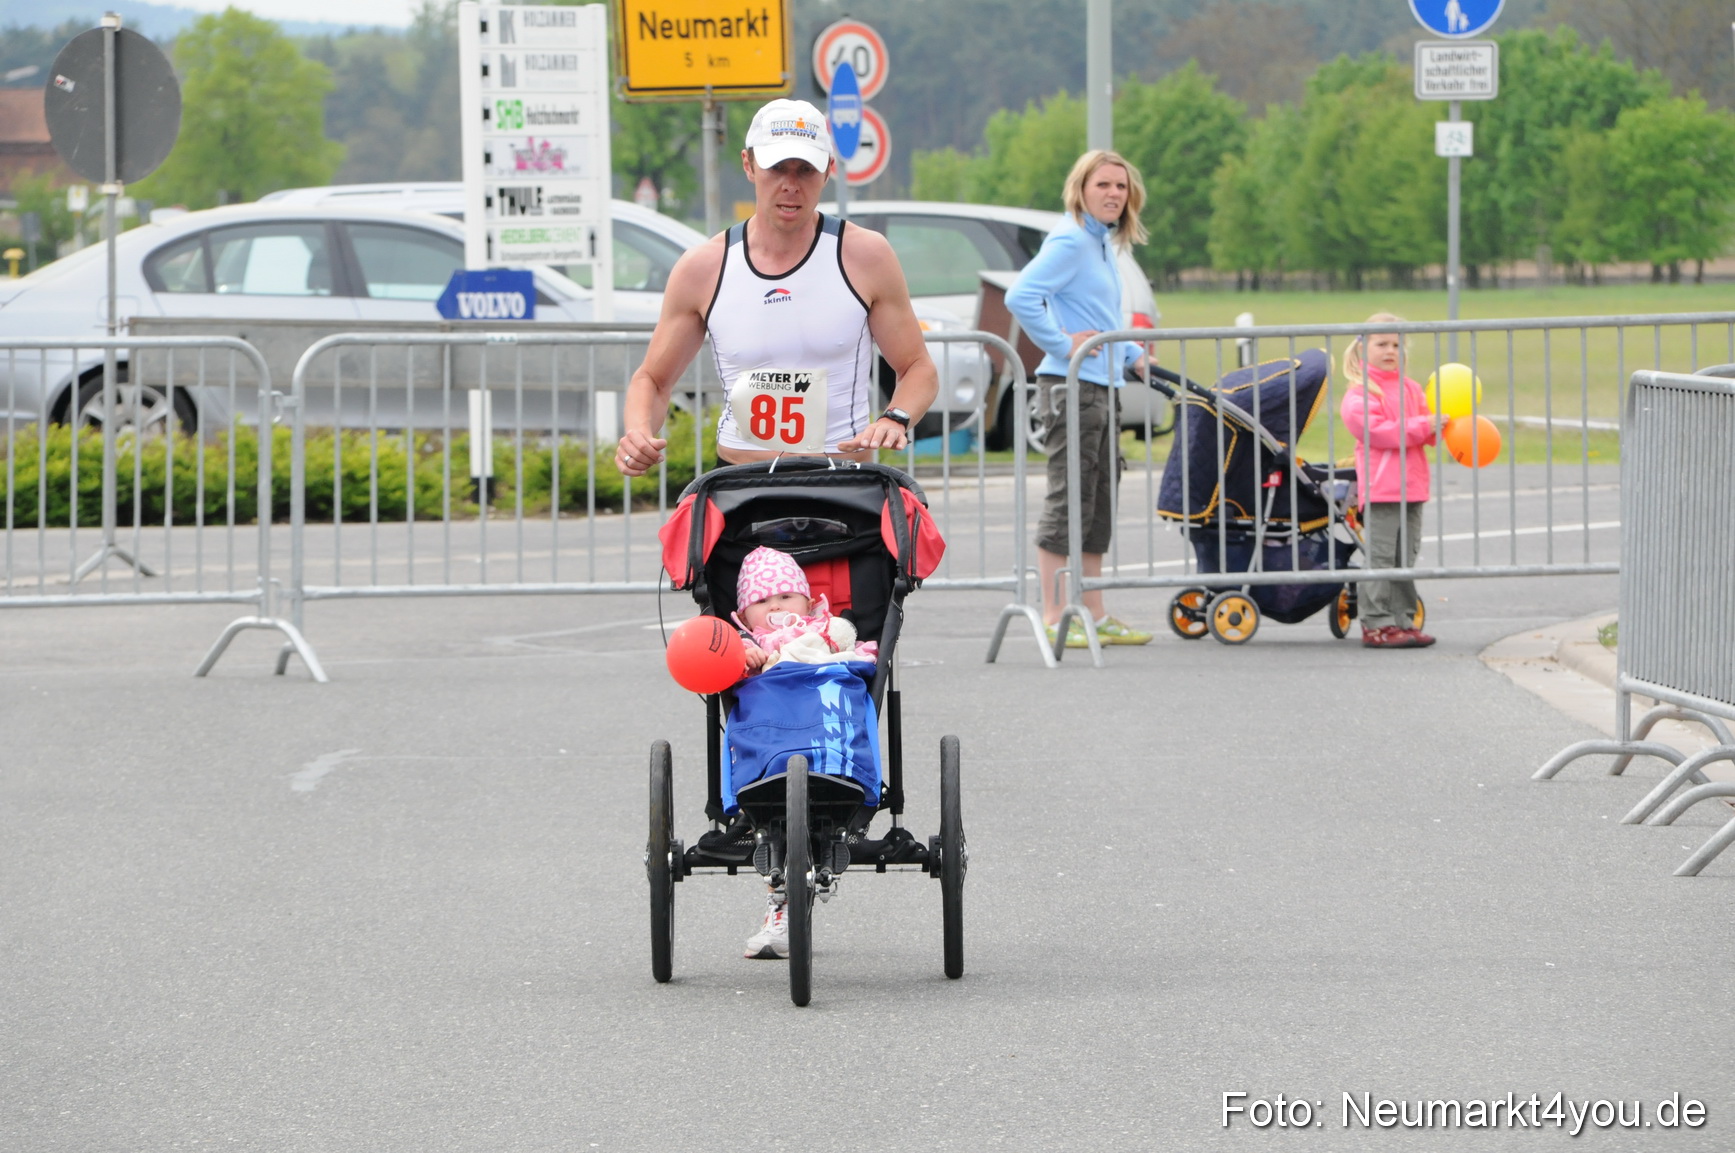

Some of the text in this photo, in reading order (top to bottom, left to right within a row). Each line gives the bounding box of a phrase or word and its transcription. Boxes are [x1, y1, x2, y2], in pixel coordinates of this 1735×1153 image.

[639, 8, 769, 40] Neumarkt
[684, 52, 731, 68] 5 km
[1430, 49, 1483, 62] Landwirt-
[1425, 64, 1488, 77] schaftlicher
[1424, 79, 1489, 91] Verkehr frei
[496, 99, 524, 129] SHB
[498, 186, 544, 216] THULE
[456, 292, 526, 319] VOLVO
[764, 296, 792, 305] skinfit
[749, 372, 792, 383] MEYER
[748, 382, 792, 391] WERBUNG
[750, 394, 805, 445] 85
